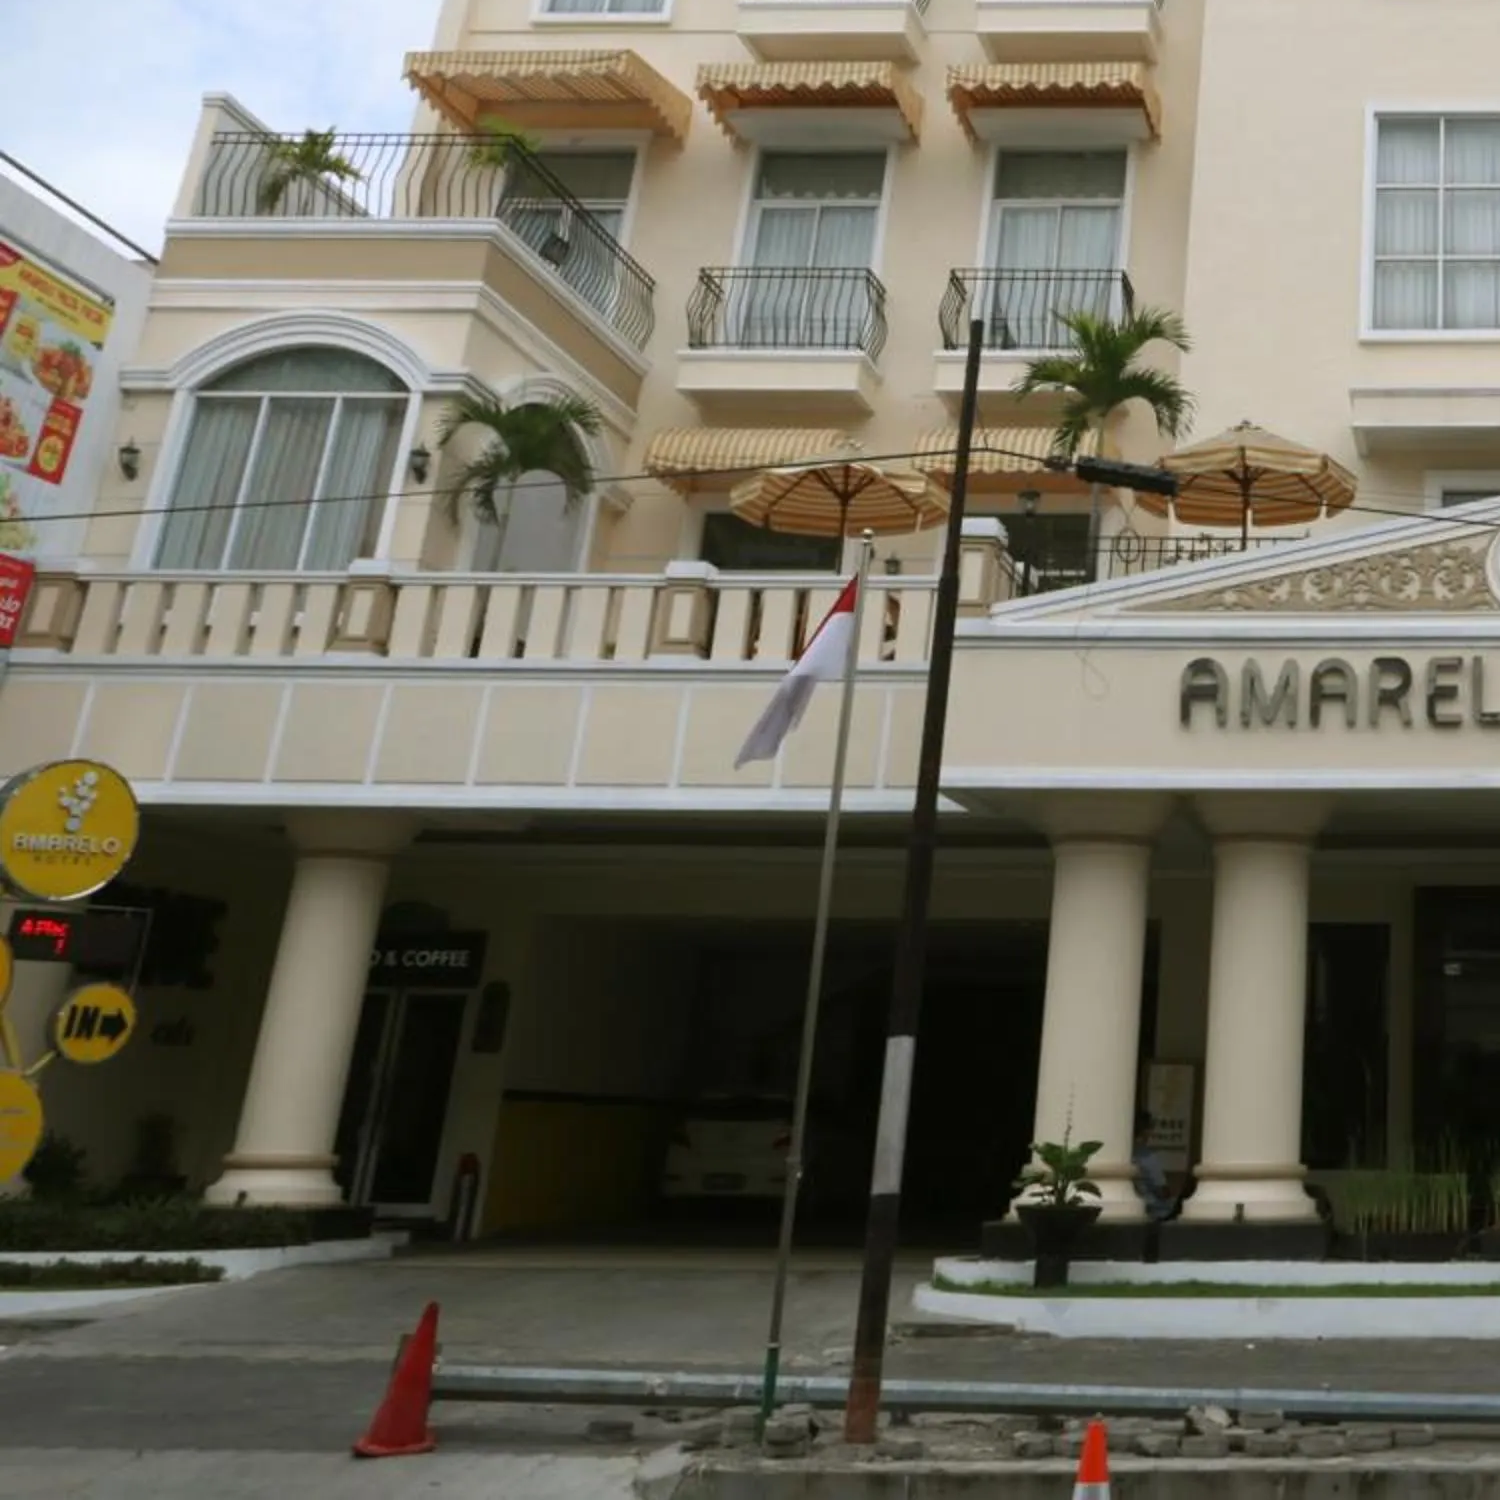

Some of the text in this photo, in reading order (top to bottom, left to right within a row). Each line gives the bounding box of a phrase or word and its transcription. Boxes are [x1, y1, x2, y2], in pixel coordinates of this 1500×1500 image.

[13, 833, 121, 856] AMARELO
[401, 948, 471, 968] COFFEE
[63, 1003, 99, 1041] IN
